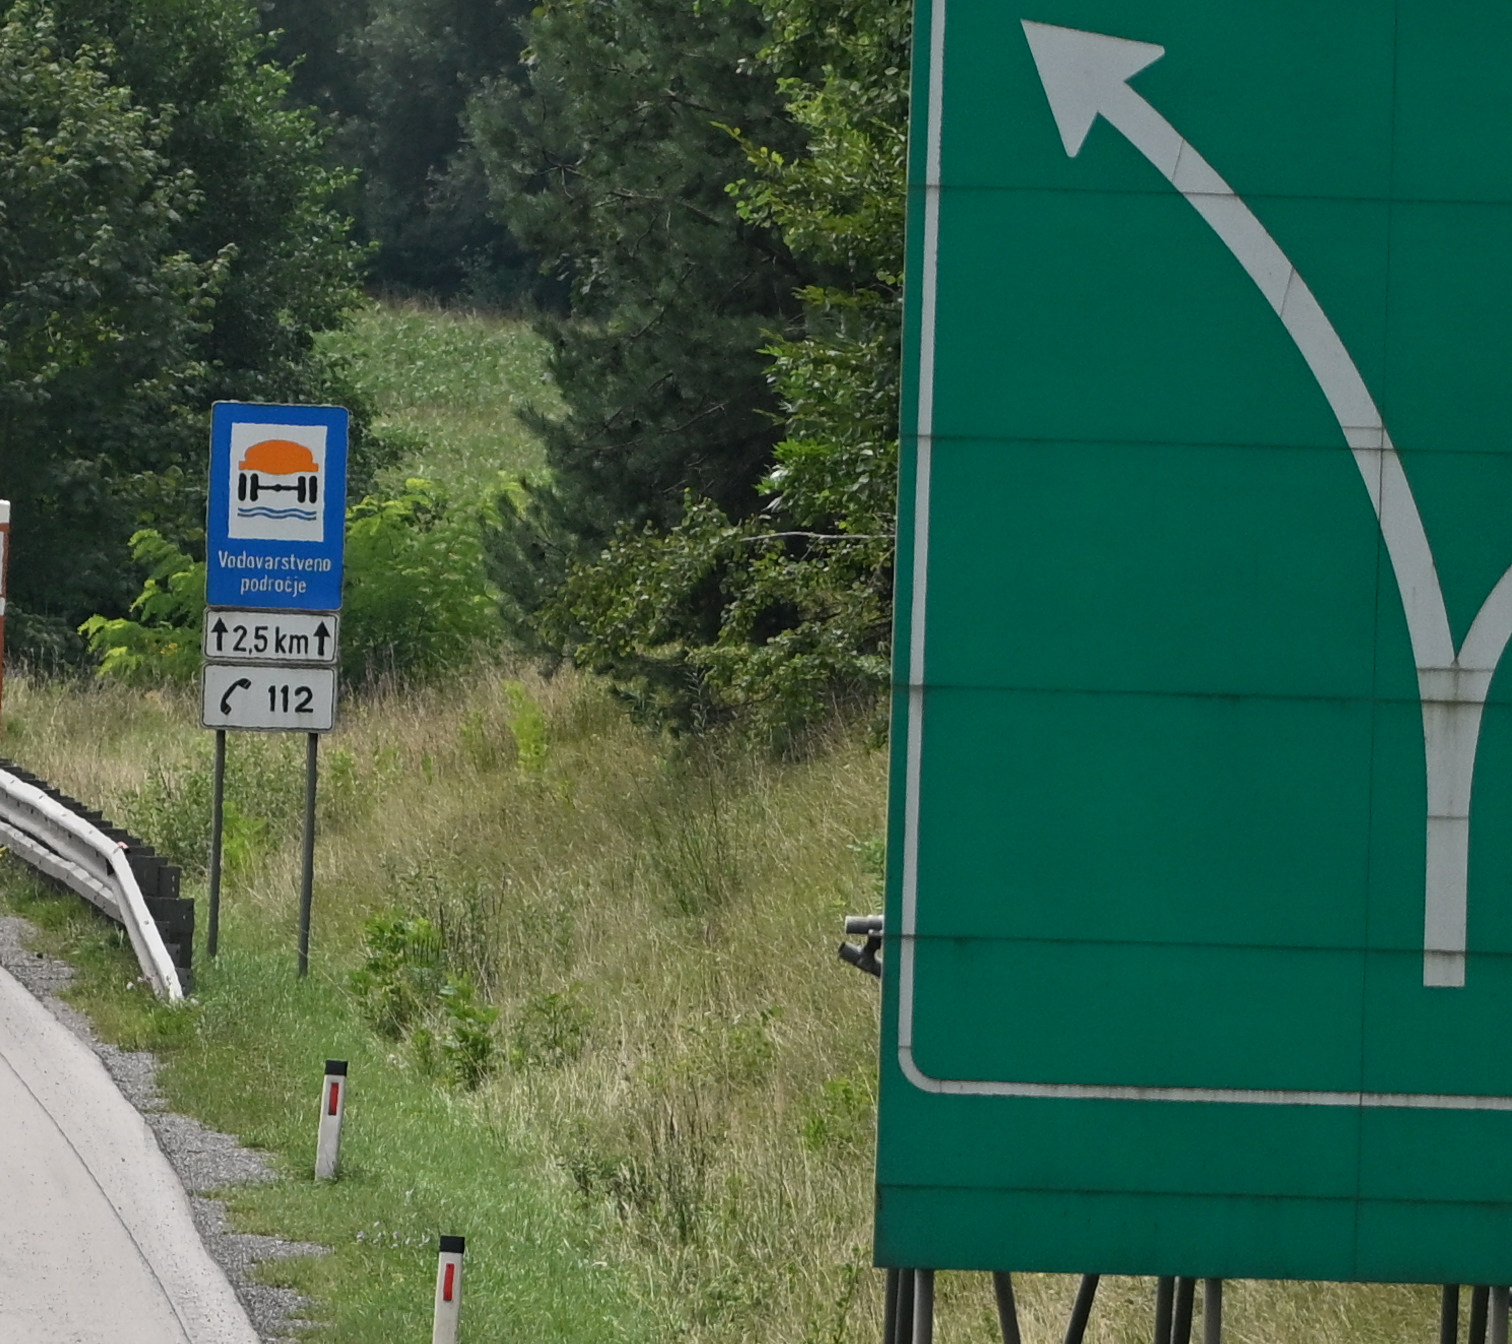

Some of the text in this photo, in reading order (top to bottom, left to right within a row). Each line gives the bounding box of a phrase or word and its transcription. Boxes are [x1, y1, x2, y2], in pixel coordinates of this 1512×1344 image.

[218, 550, 332, 572] Vodovarstveno
[233, 624, 309, 656] 2,5 km
[268, 685, 314, 714] 112
